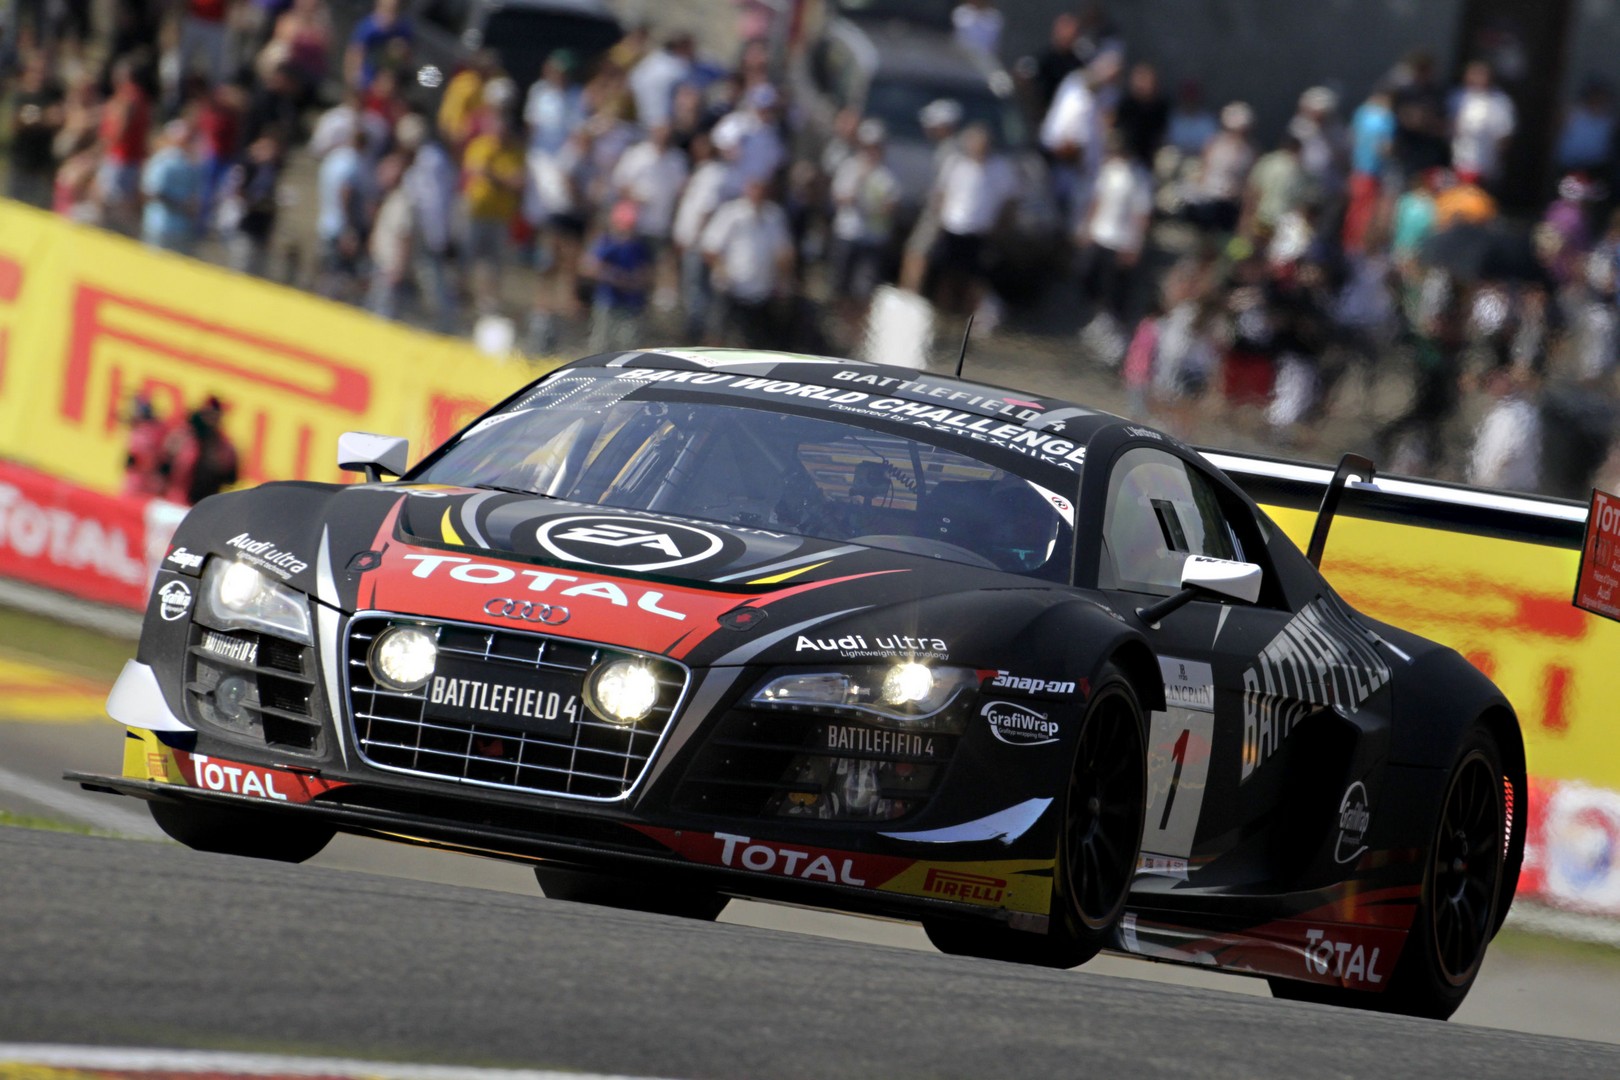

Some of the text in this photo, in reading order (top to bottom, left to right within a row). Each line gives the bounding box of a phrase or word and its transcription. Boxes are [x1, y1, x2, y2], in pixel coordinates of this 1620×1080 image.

[614, 368, 1087, 464] BAKU WORLD CHALLENGE
[832, 371, 1068, 433] BATTLEFIELD 4
[829, 403, 1076, 472] Powered by AZTEXNIKA
[1595, 493, 1620, 537] TOT
[226, 532, 309, 574] Audi ultra
[554, 524, 683, 558] EA
[404, 553, 687, 621] TOTAL
[796, 635, 948, 652] Audi ultra
[840, 650, 950, 661] Lightweight technology
[431, 675, 577, 723] BATTLEFIELD 4
[992, 669, 1076, 694] Snap-on
[987, 709, 1059, 737] GrafiWrap
[925, 737, 935, 757] 4
[188, 751, 288, 801] TOTAL
[1158, 728, 1191, 830] 1
[713, 831, 866, 887] TOTAL
[923, 867, 1008, 902] PIRELLI
[1305, 928, 1383, 984] TOTAL
